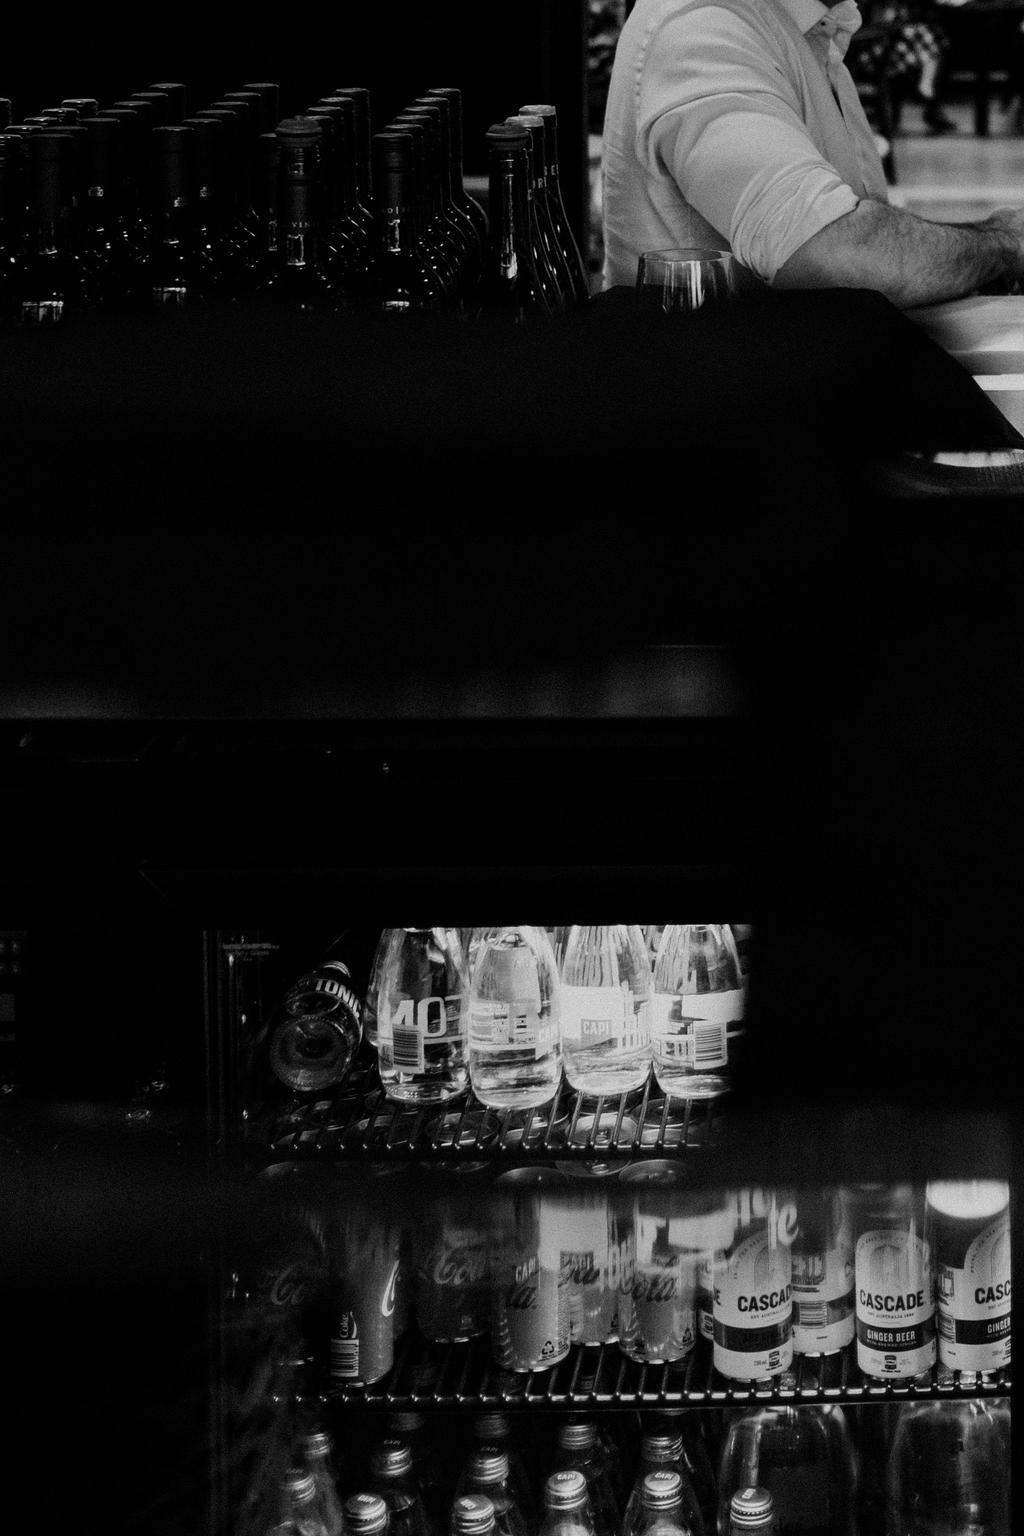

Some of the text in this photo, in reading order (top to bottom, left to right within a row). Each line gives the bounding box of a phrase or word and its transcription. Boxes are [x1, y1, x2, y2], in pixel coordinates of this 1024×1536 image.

[583, 1020, 612, 1035] CAPI
[737, 1283, 793, 1312] CASCAD
[860, 1289, 924, 1312] CASCADE
[974, 1279, 1010, 1304] CASC
[866, 1328, 915, 1342] GINGER BEER
